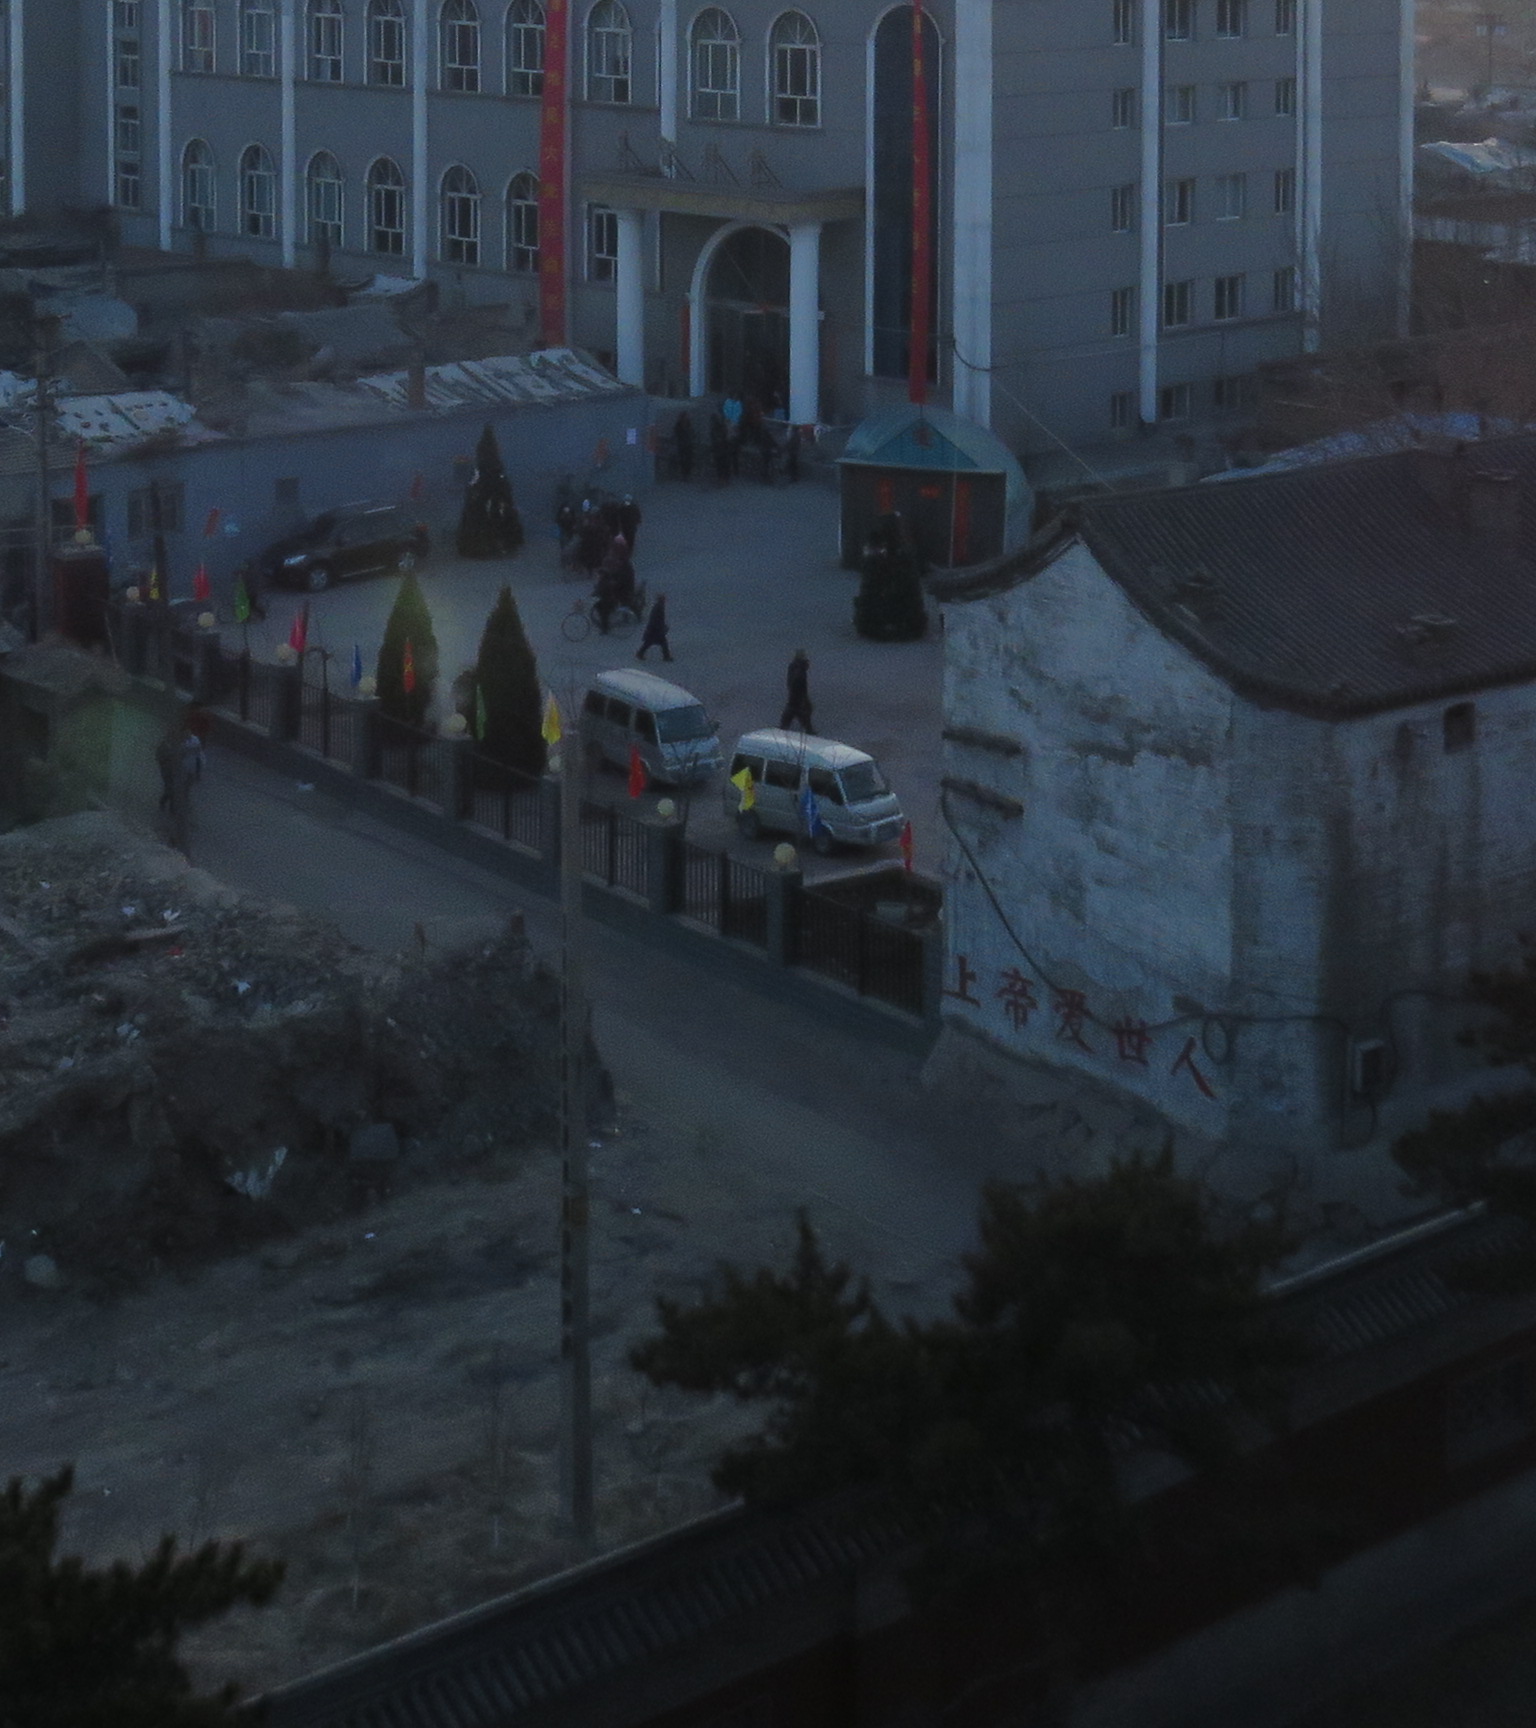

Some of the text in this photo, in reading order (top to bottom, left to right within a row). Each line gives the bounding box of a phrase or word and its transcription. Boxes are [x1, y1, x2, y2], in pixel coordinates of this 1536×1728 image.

[942, 955, 1218, 1100] 上帝爱世人
